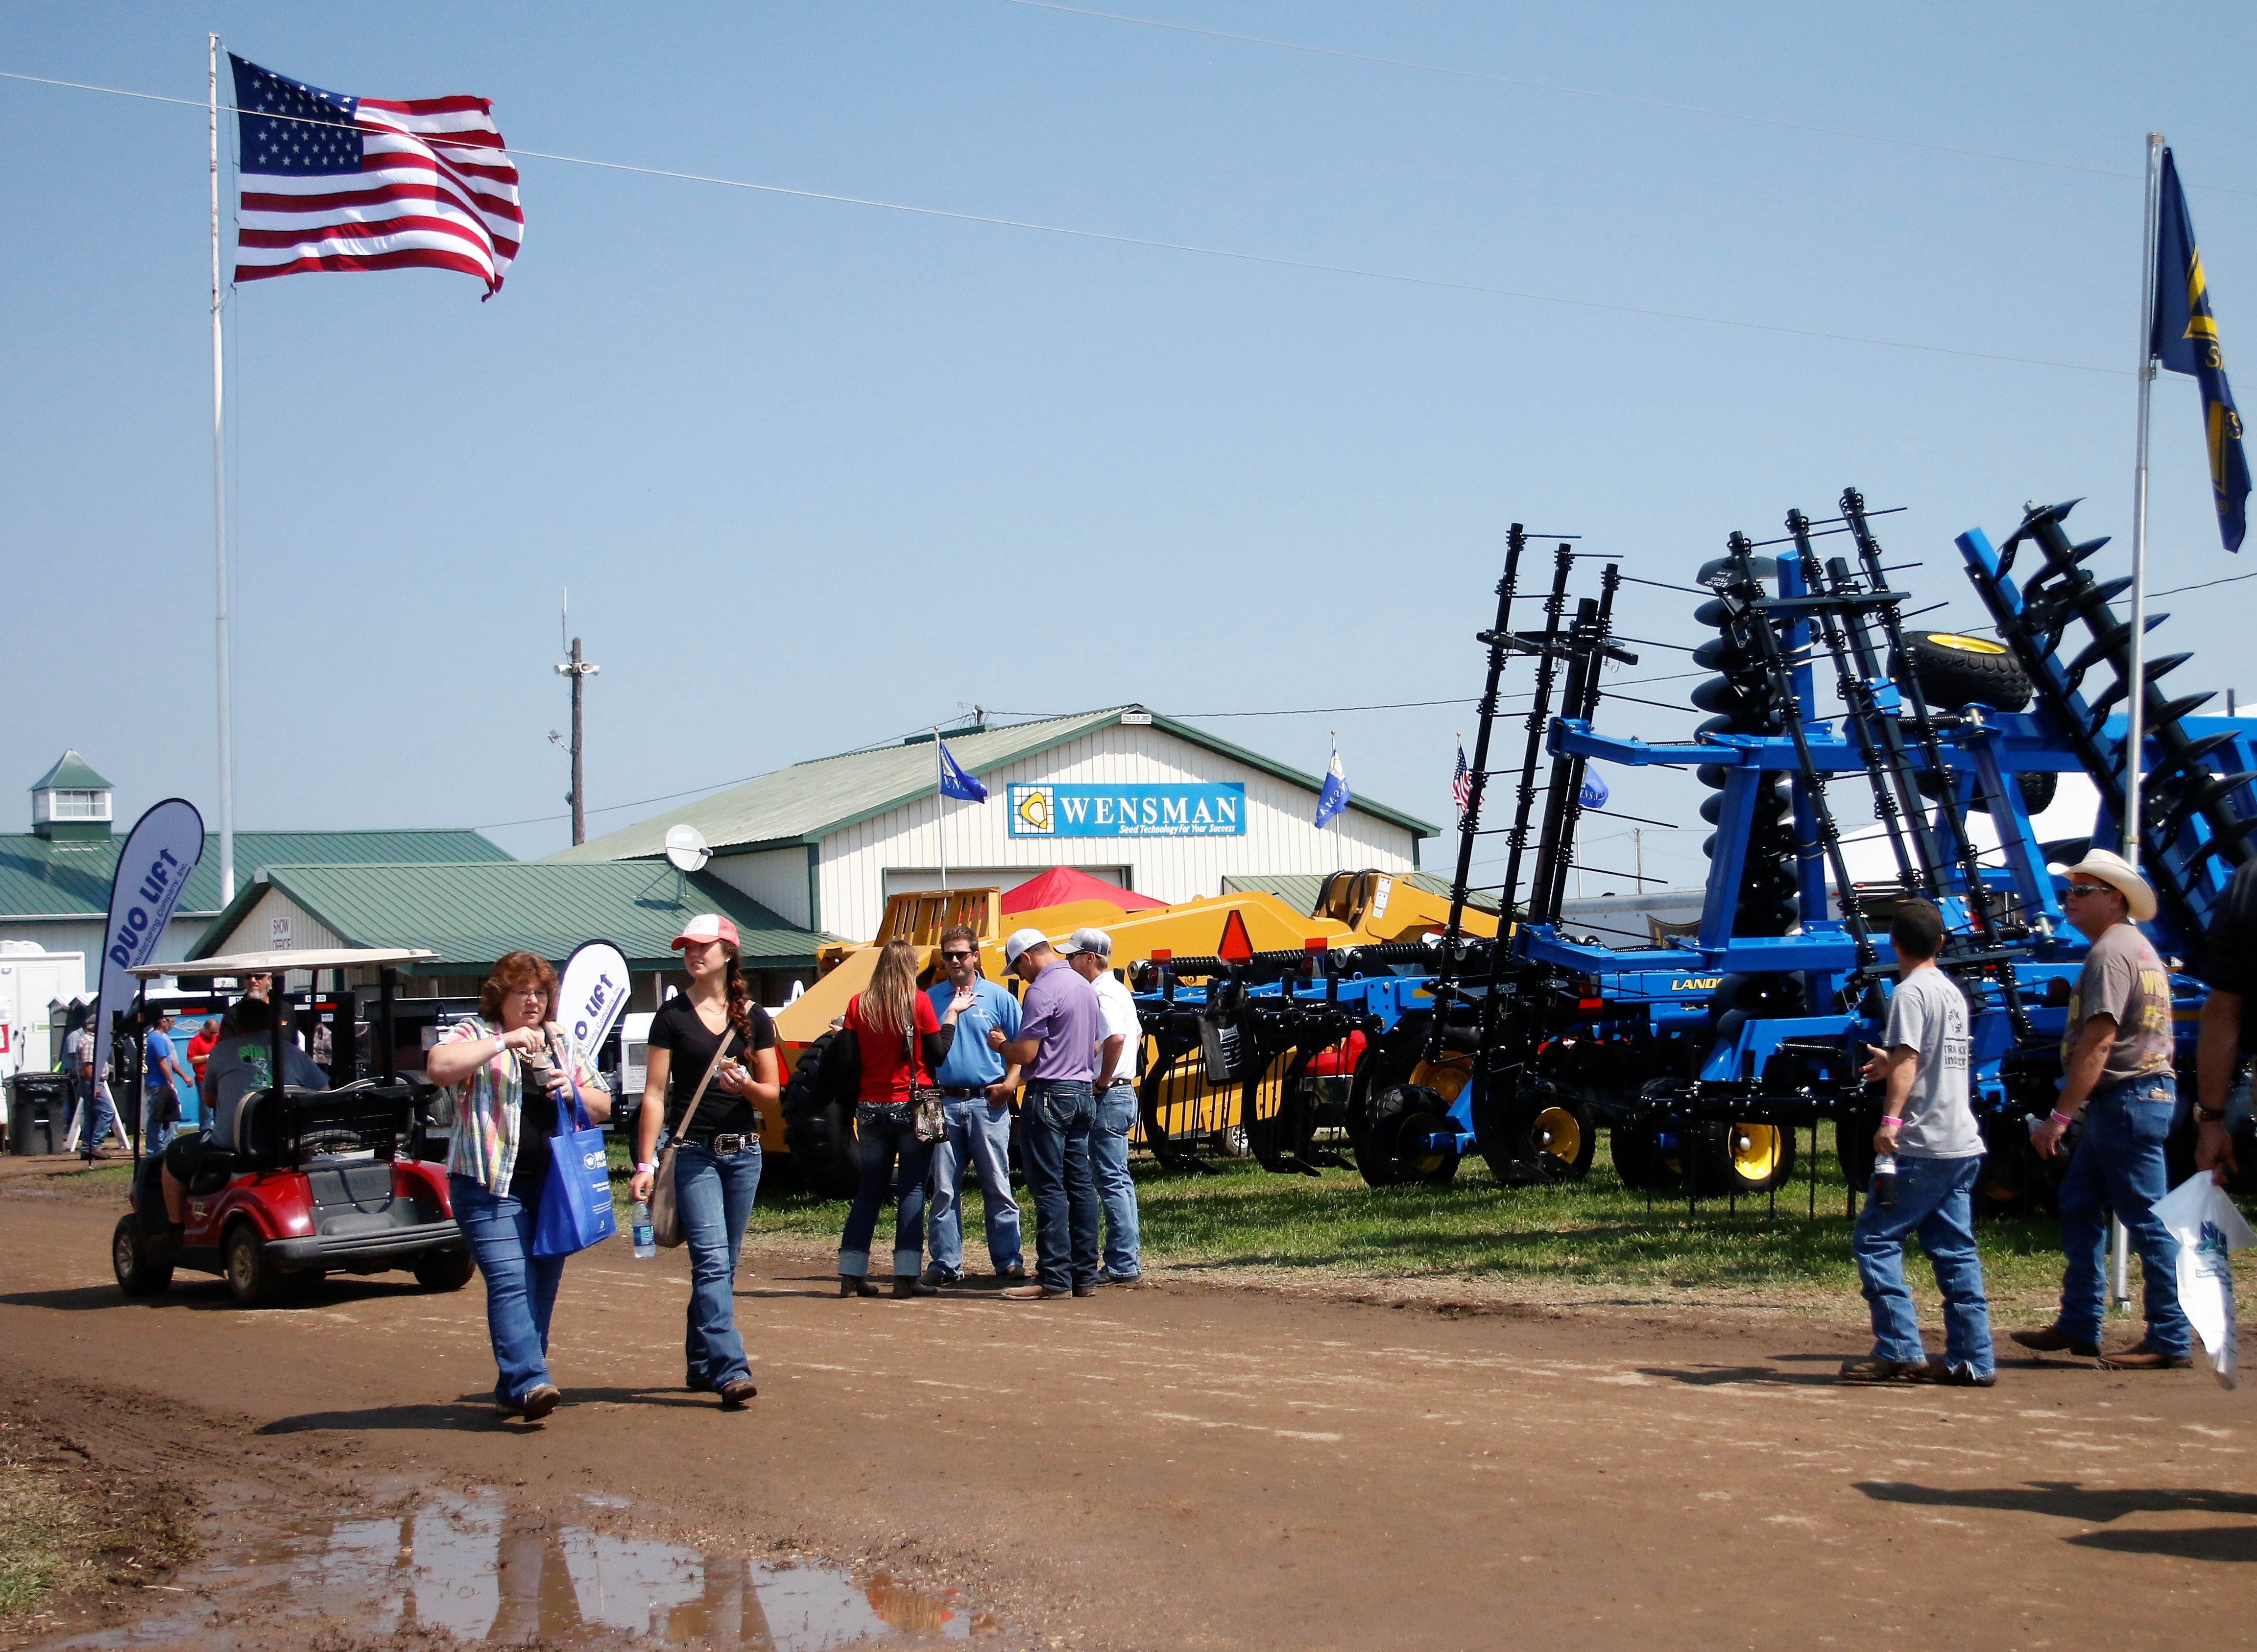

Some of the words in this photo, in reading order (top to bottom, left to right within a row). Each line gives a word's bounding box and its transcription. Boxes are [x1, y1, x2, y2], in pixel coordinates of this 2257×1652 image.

[1059, 797, 1237, 824] WENSMAN
[1119, 825, 1139, 834] Seed
[1140, 824, 1178, 835] Technology
[1178, 824, 1191, 833] For
[1191, 824, 1207, 833] Your
[1209, 824, 1236, 833] Success
[109, 906, 148, 969] DUO
[140, 847, 178, 904] LIFT
[132, 918, 161, 966] anufacturing
[274, 919, 288, 934] SHOW
[585, 974, 613, 1017] LIFT
